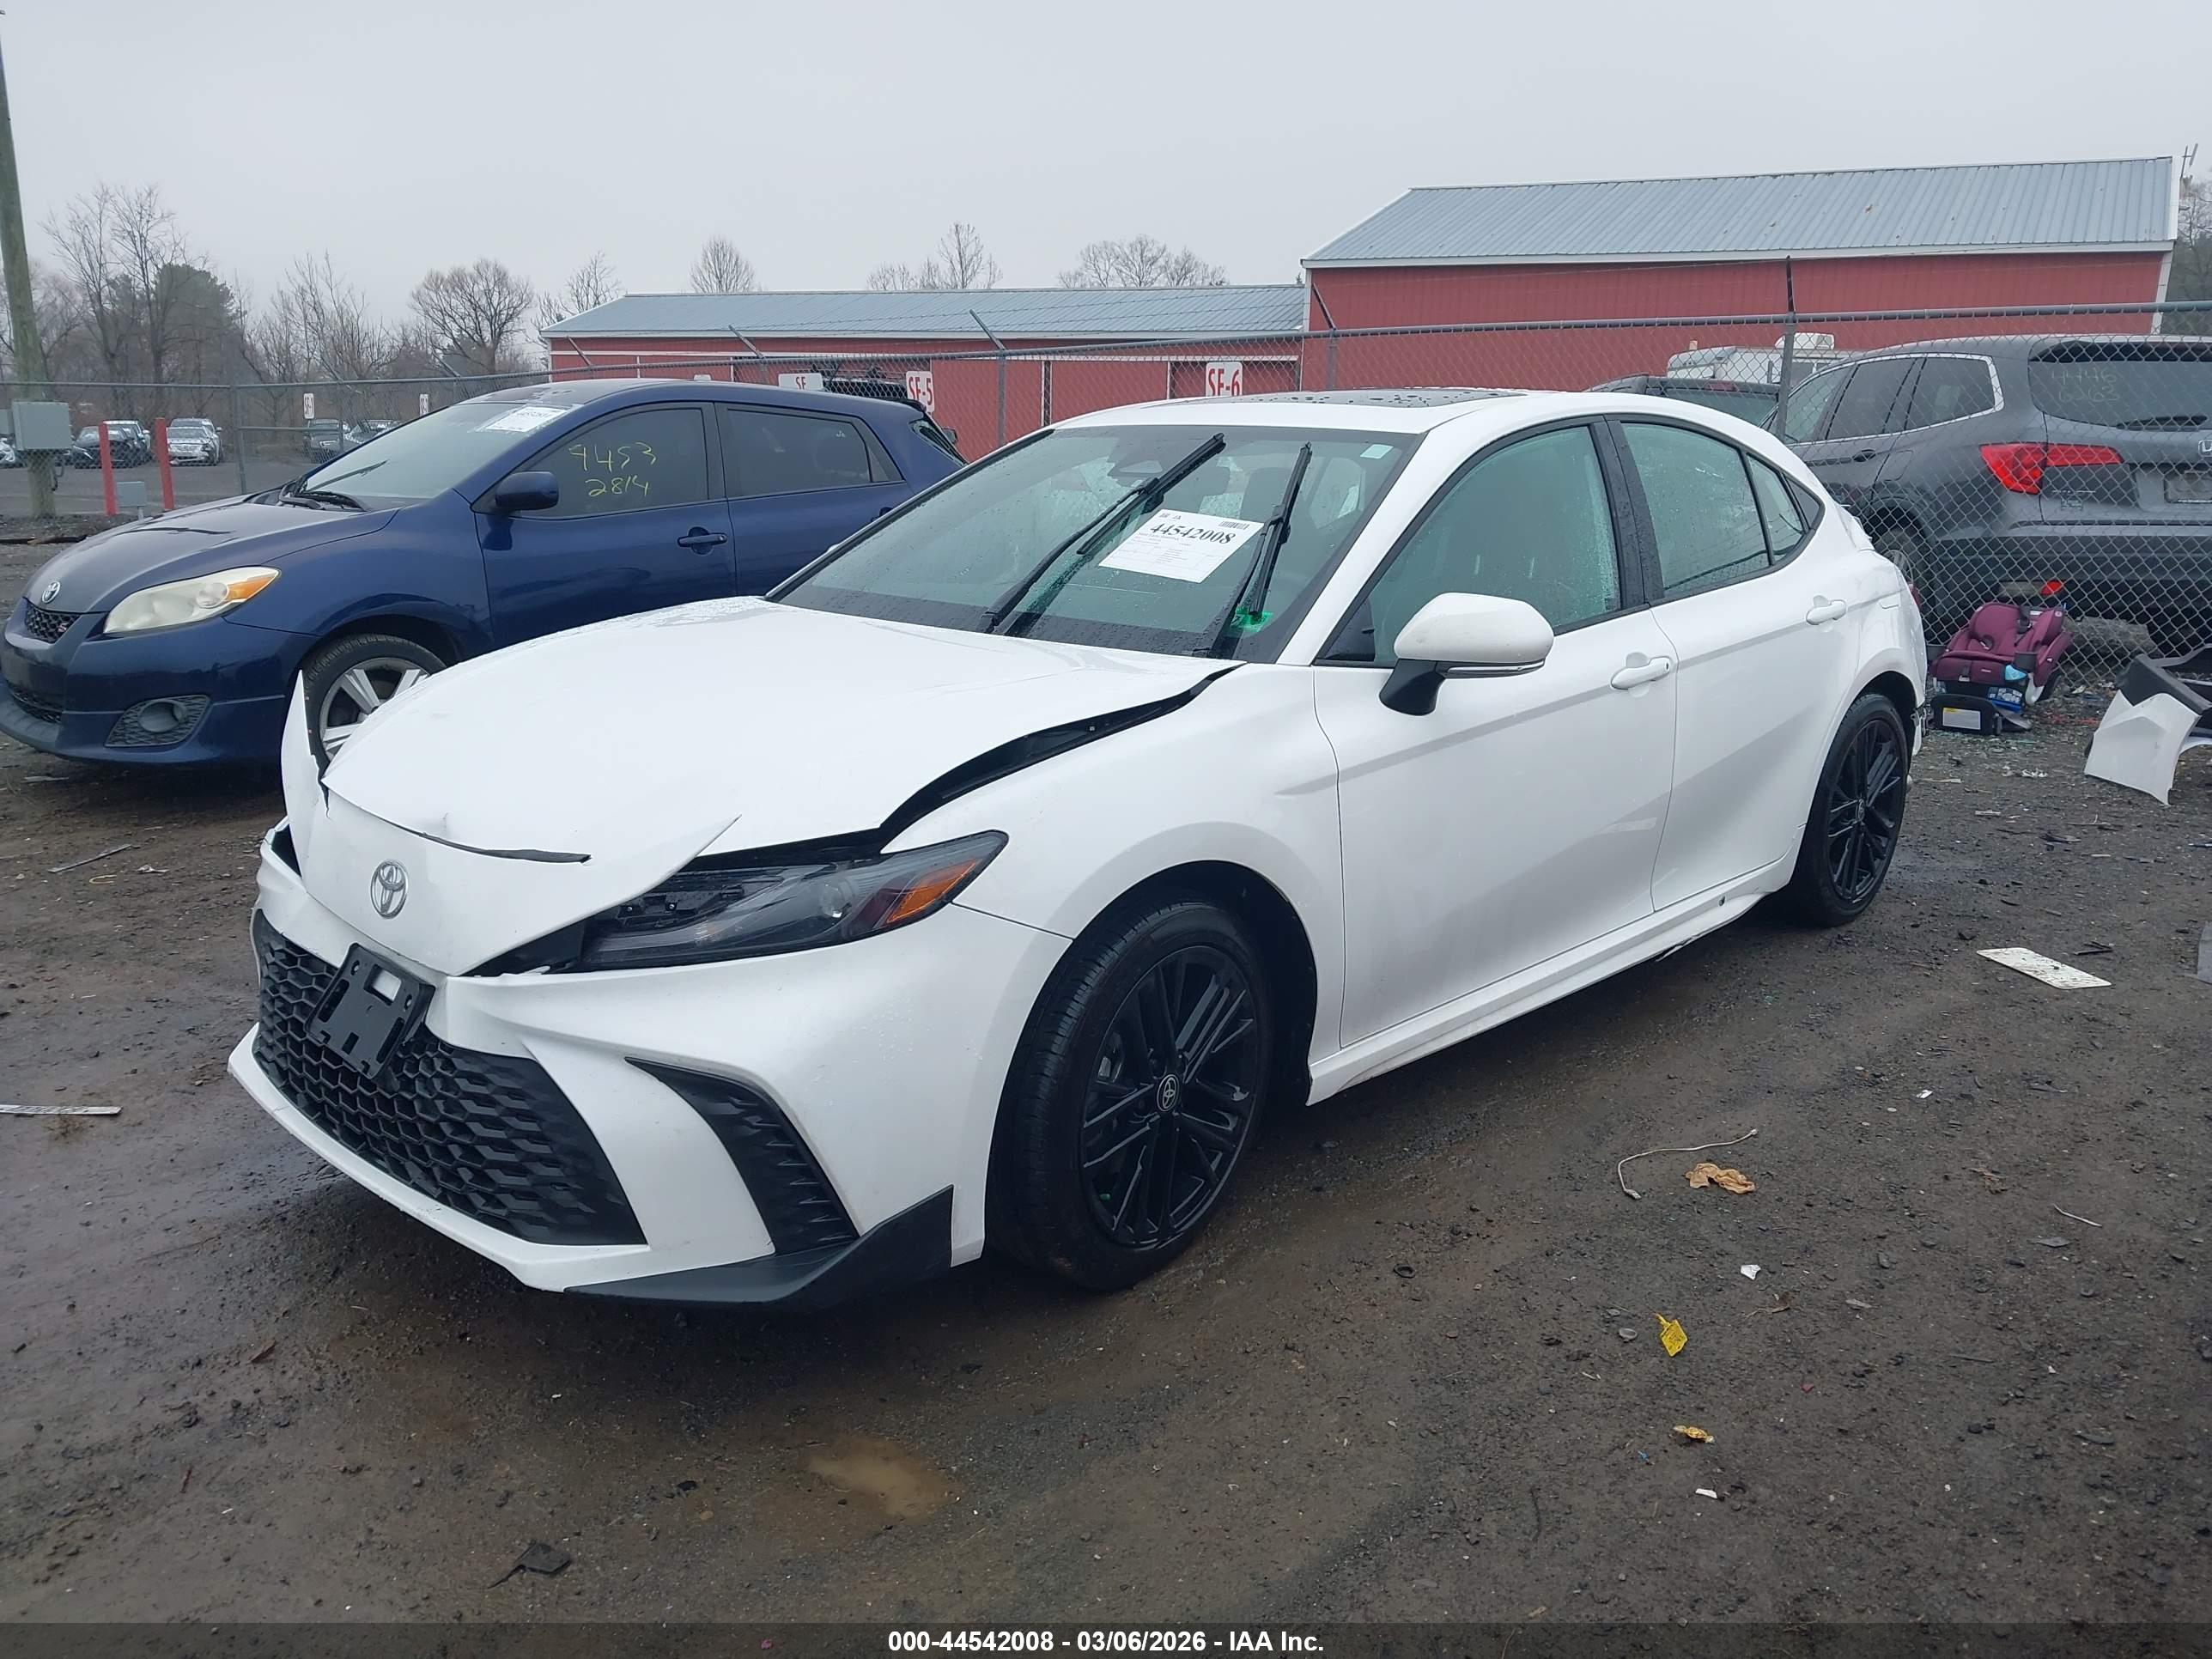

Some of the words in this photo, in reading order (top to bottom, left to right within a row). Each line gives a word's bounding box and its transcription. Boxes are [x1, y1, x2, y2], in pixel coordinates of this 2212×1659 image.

[908, 376, 933, 405] SF-5
[1208, 368, 1240, 396] SF-6
[568, 441, 656, 472] 9453
[585, 475, 650, 496] 2814
[1150, 523, 1236, 544] 44542008
